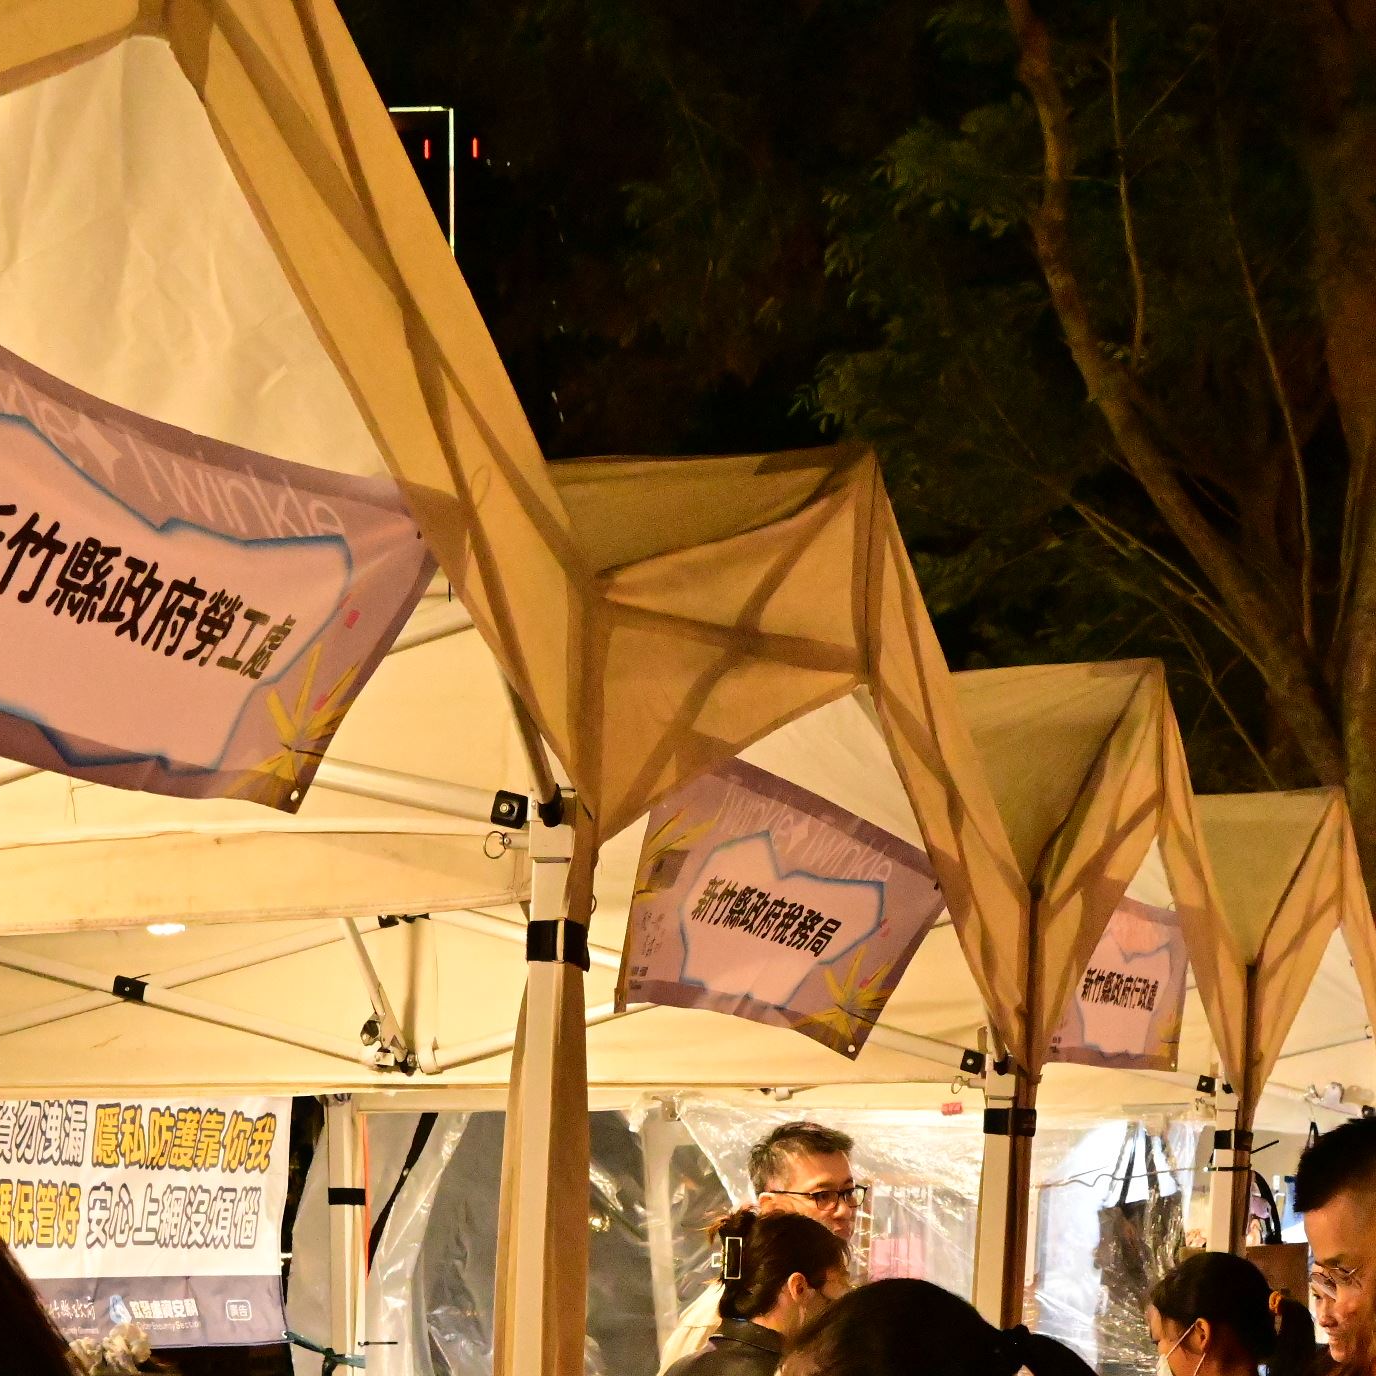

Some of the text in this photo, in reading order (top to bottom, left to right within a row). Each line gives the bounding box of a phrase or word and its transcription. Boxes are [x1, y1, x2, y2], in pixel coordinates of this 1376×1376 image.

[691, 875, 842, 958] 新竹縣政府稅務局
[92, 1102, 277, 1173] 隱私防護靠你我
[86, 1181, 262, 1249] 安心上網沒煩惱
